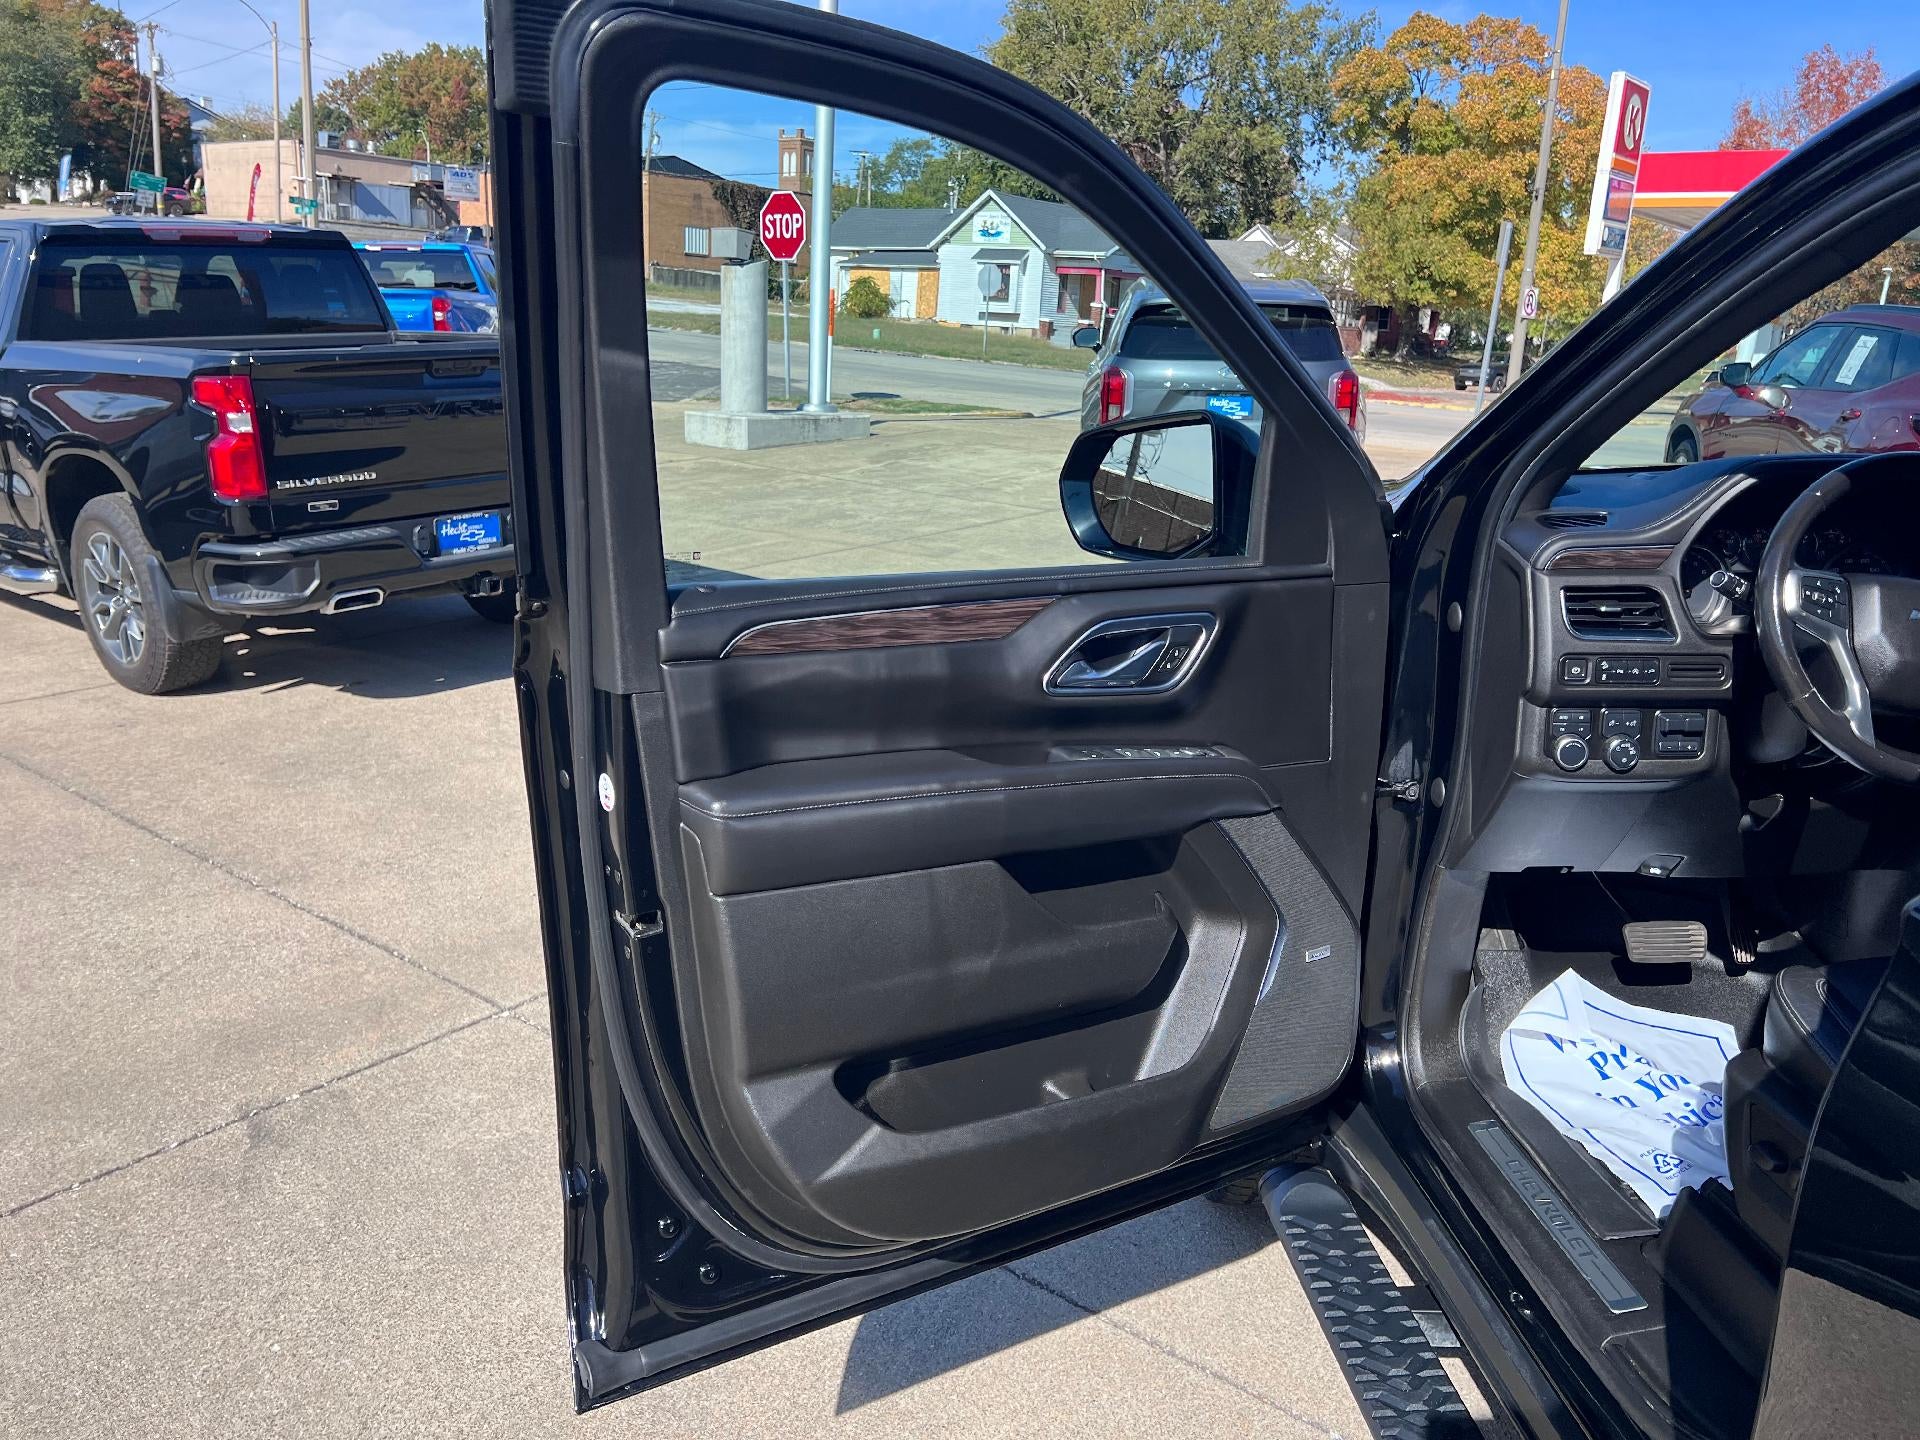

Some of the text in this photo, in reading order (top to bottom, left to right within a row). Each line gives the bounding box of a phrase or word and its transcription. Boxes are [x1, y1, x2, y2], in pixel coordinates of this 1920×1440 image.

[1626, 103, 1641, 148] K
[764, 213, 802, 239] STOP
[276, 471, 377, 490] SILVERADO
[441, 521, 468, 537] Hecht
[1506, 1160, 1599, 1259] CHEVROLET
